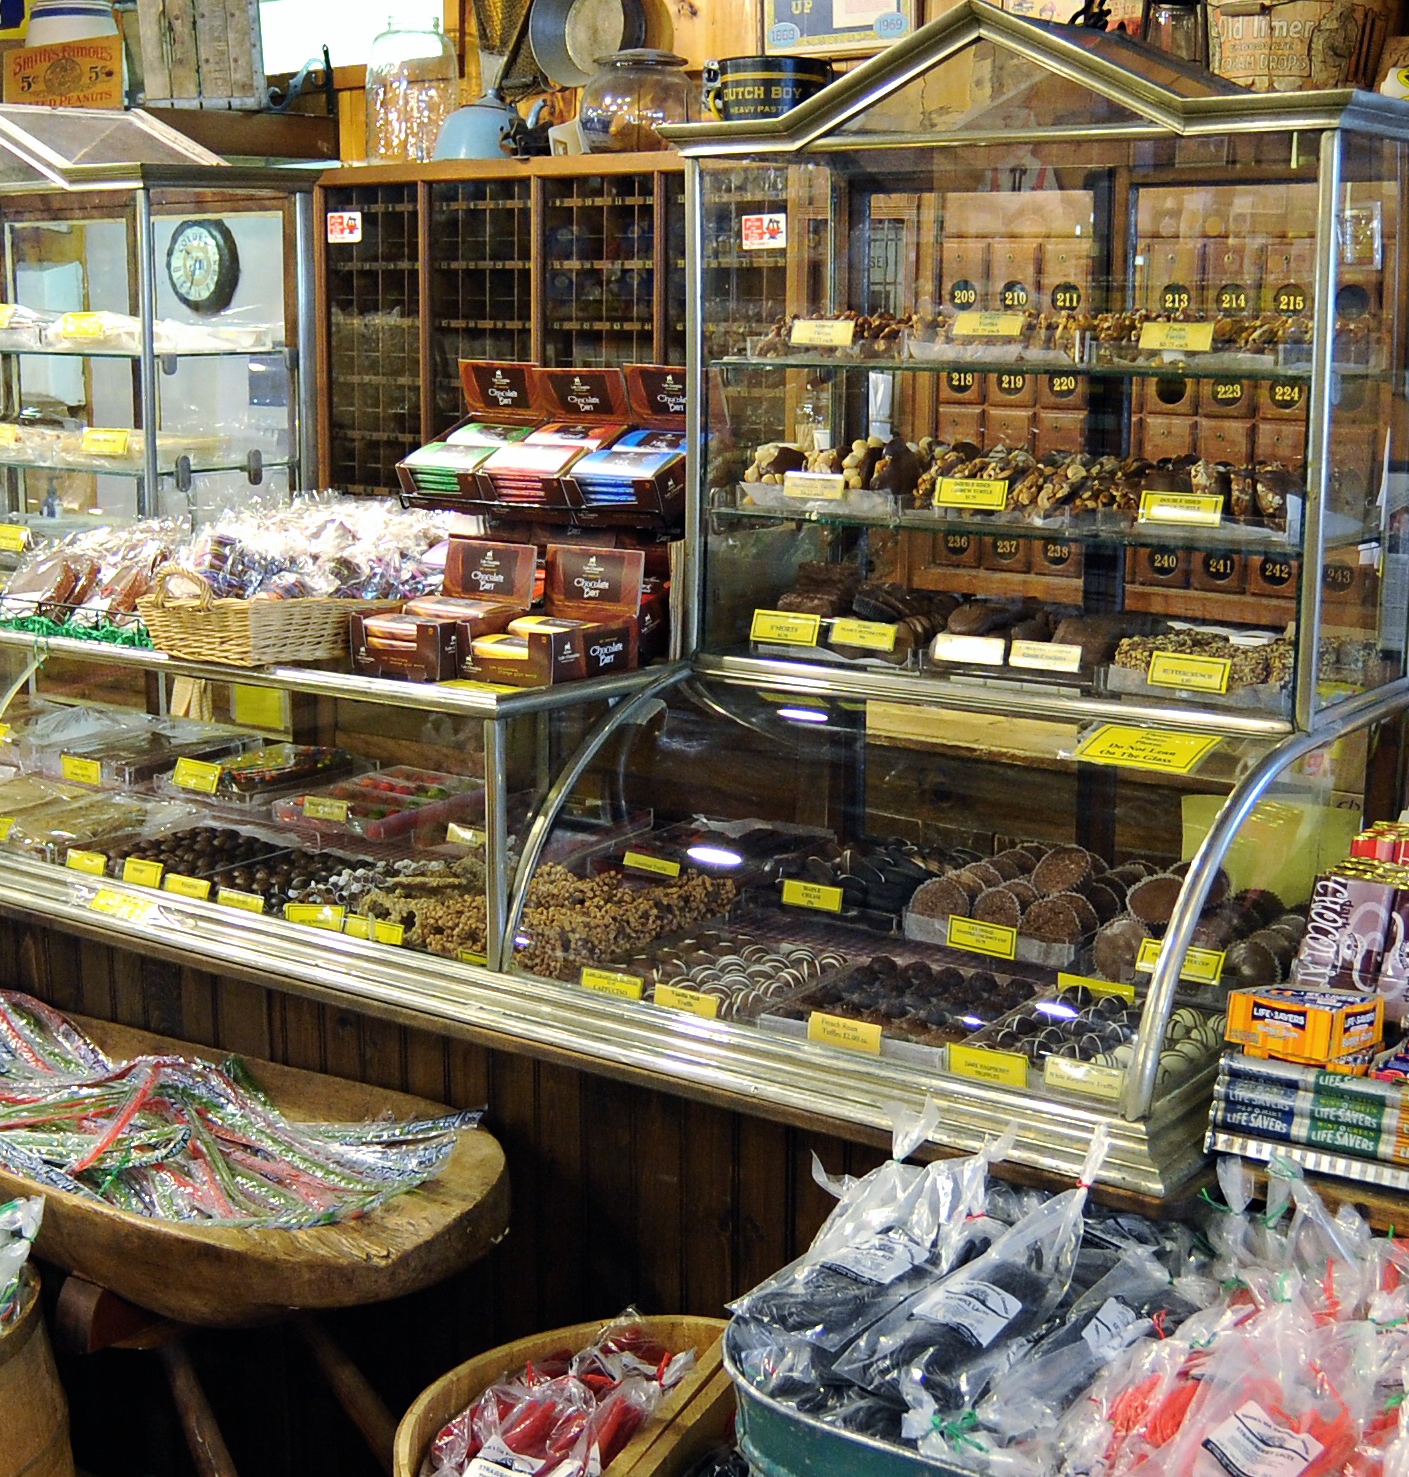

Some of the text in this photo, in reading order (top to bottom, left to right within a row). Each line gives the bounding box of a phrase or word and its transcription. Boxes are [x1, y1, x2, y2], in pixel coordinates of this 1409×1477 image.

[877, 18, 903, 31] 1969
[1259, 54, 1308, 71] DROPS
[771, 87, 803, 100] BOY
[953, 290, 976, 304] 209
[1005, 291, 1027, 305] 210
[1056, 293, 1079, 307] 211
[1165, 293, 1189, 308] 213
[1222, 294, 1246, 308] 214
[1279, 295, 1304, 311] 215
[951, 372, 973, 386] 218
[1001, 374, 1023, 388] 219
[1053, 376, 1075, 391] 220
[1217, 384, 1242, 399] 223
[1275, 386, 1300, 401] 224
[948, 536, 969, 548] 236
[997, 541, 1018, 553] 237
[1047, 545, 1069, 558] 238
[1154, 553, 1177, 567] 240
[1209, 558, 1232, 574] 241
[1265, 563, 1289, 577] 242
[1121, 751, 1139, 759] The
[1143, 753, 1172, 763] Glass
[1227, 1113, 1288, 1134] LIFE SAVERS
[1315, 1108, 1378, 1128] LIFE SAVERS
[1311, 1130, 1375, 1151] LIFE SAVERS
